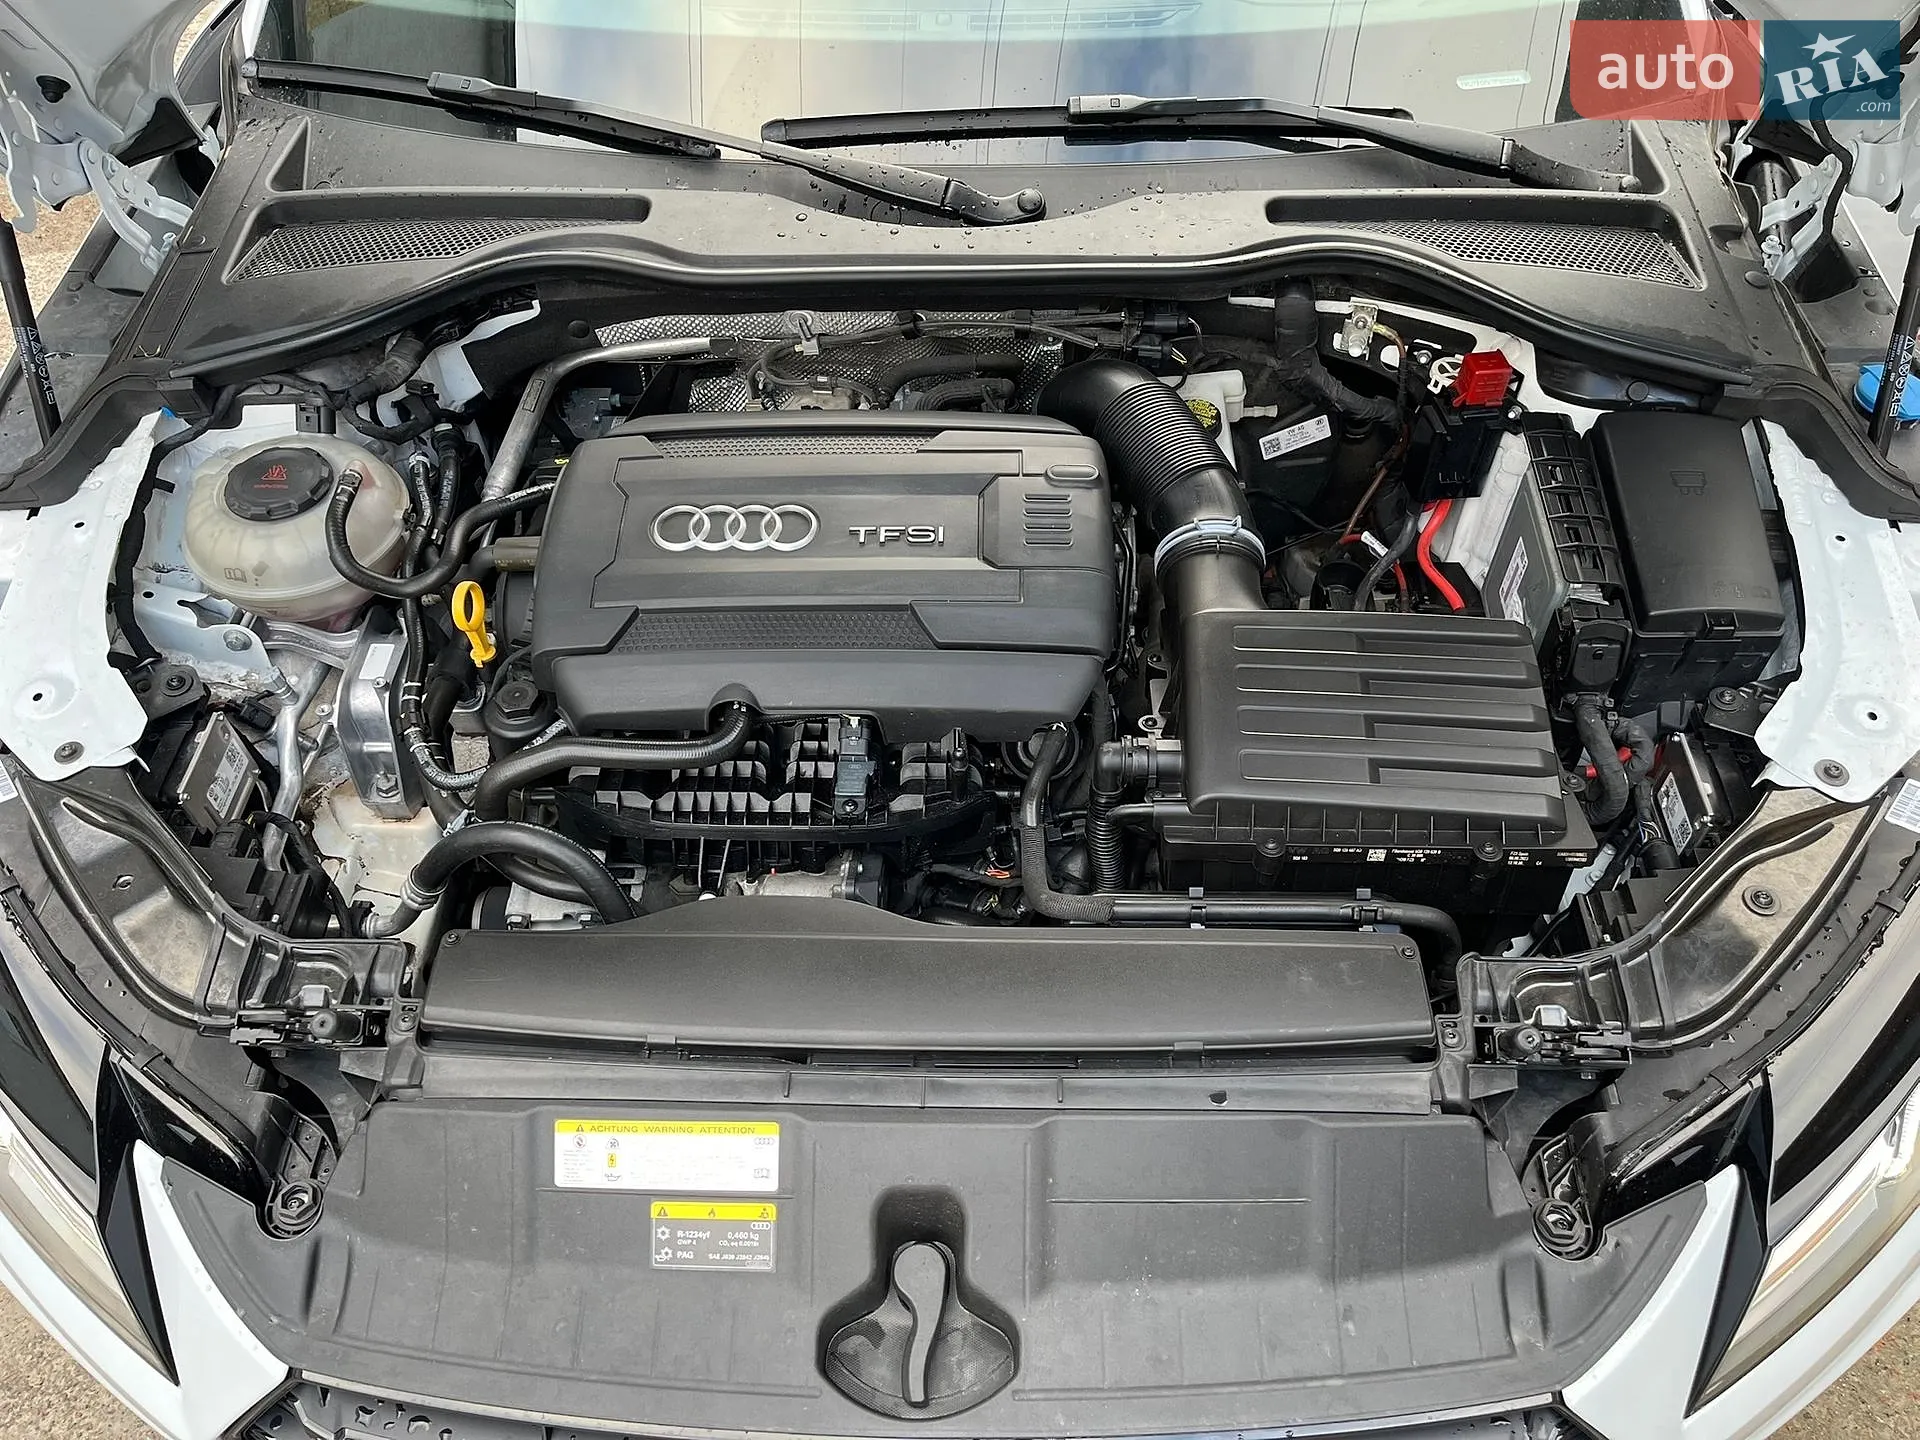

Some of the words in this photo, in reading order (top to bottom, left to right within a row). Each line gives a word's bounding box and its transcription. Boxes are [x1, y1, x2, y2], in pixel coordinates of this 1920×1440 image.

[848, 526, 944, 545] TFSI
[590, 1125, 639, 1133] ACHTUNG
[643, 1125, 694, 1134] WARNING
[700, 1126, 755, 1134] ATTENTION
